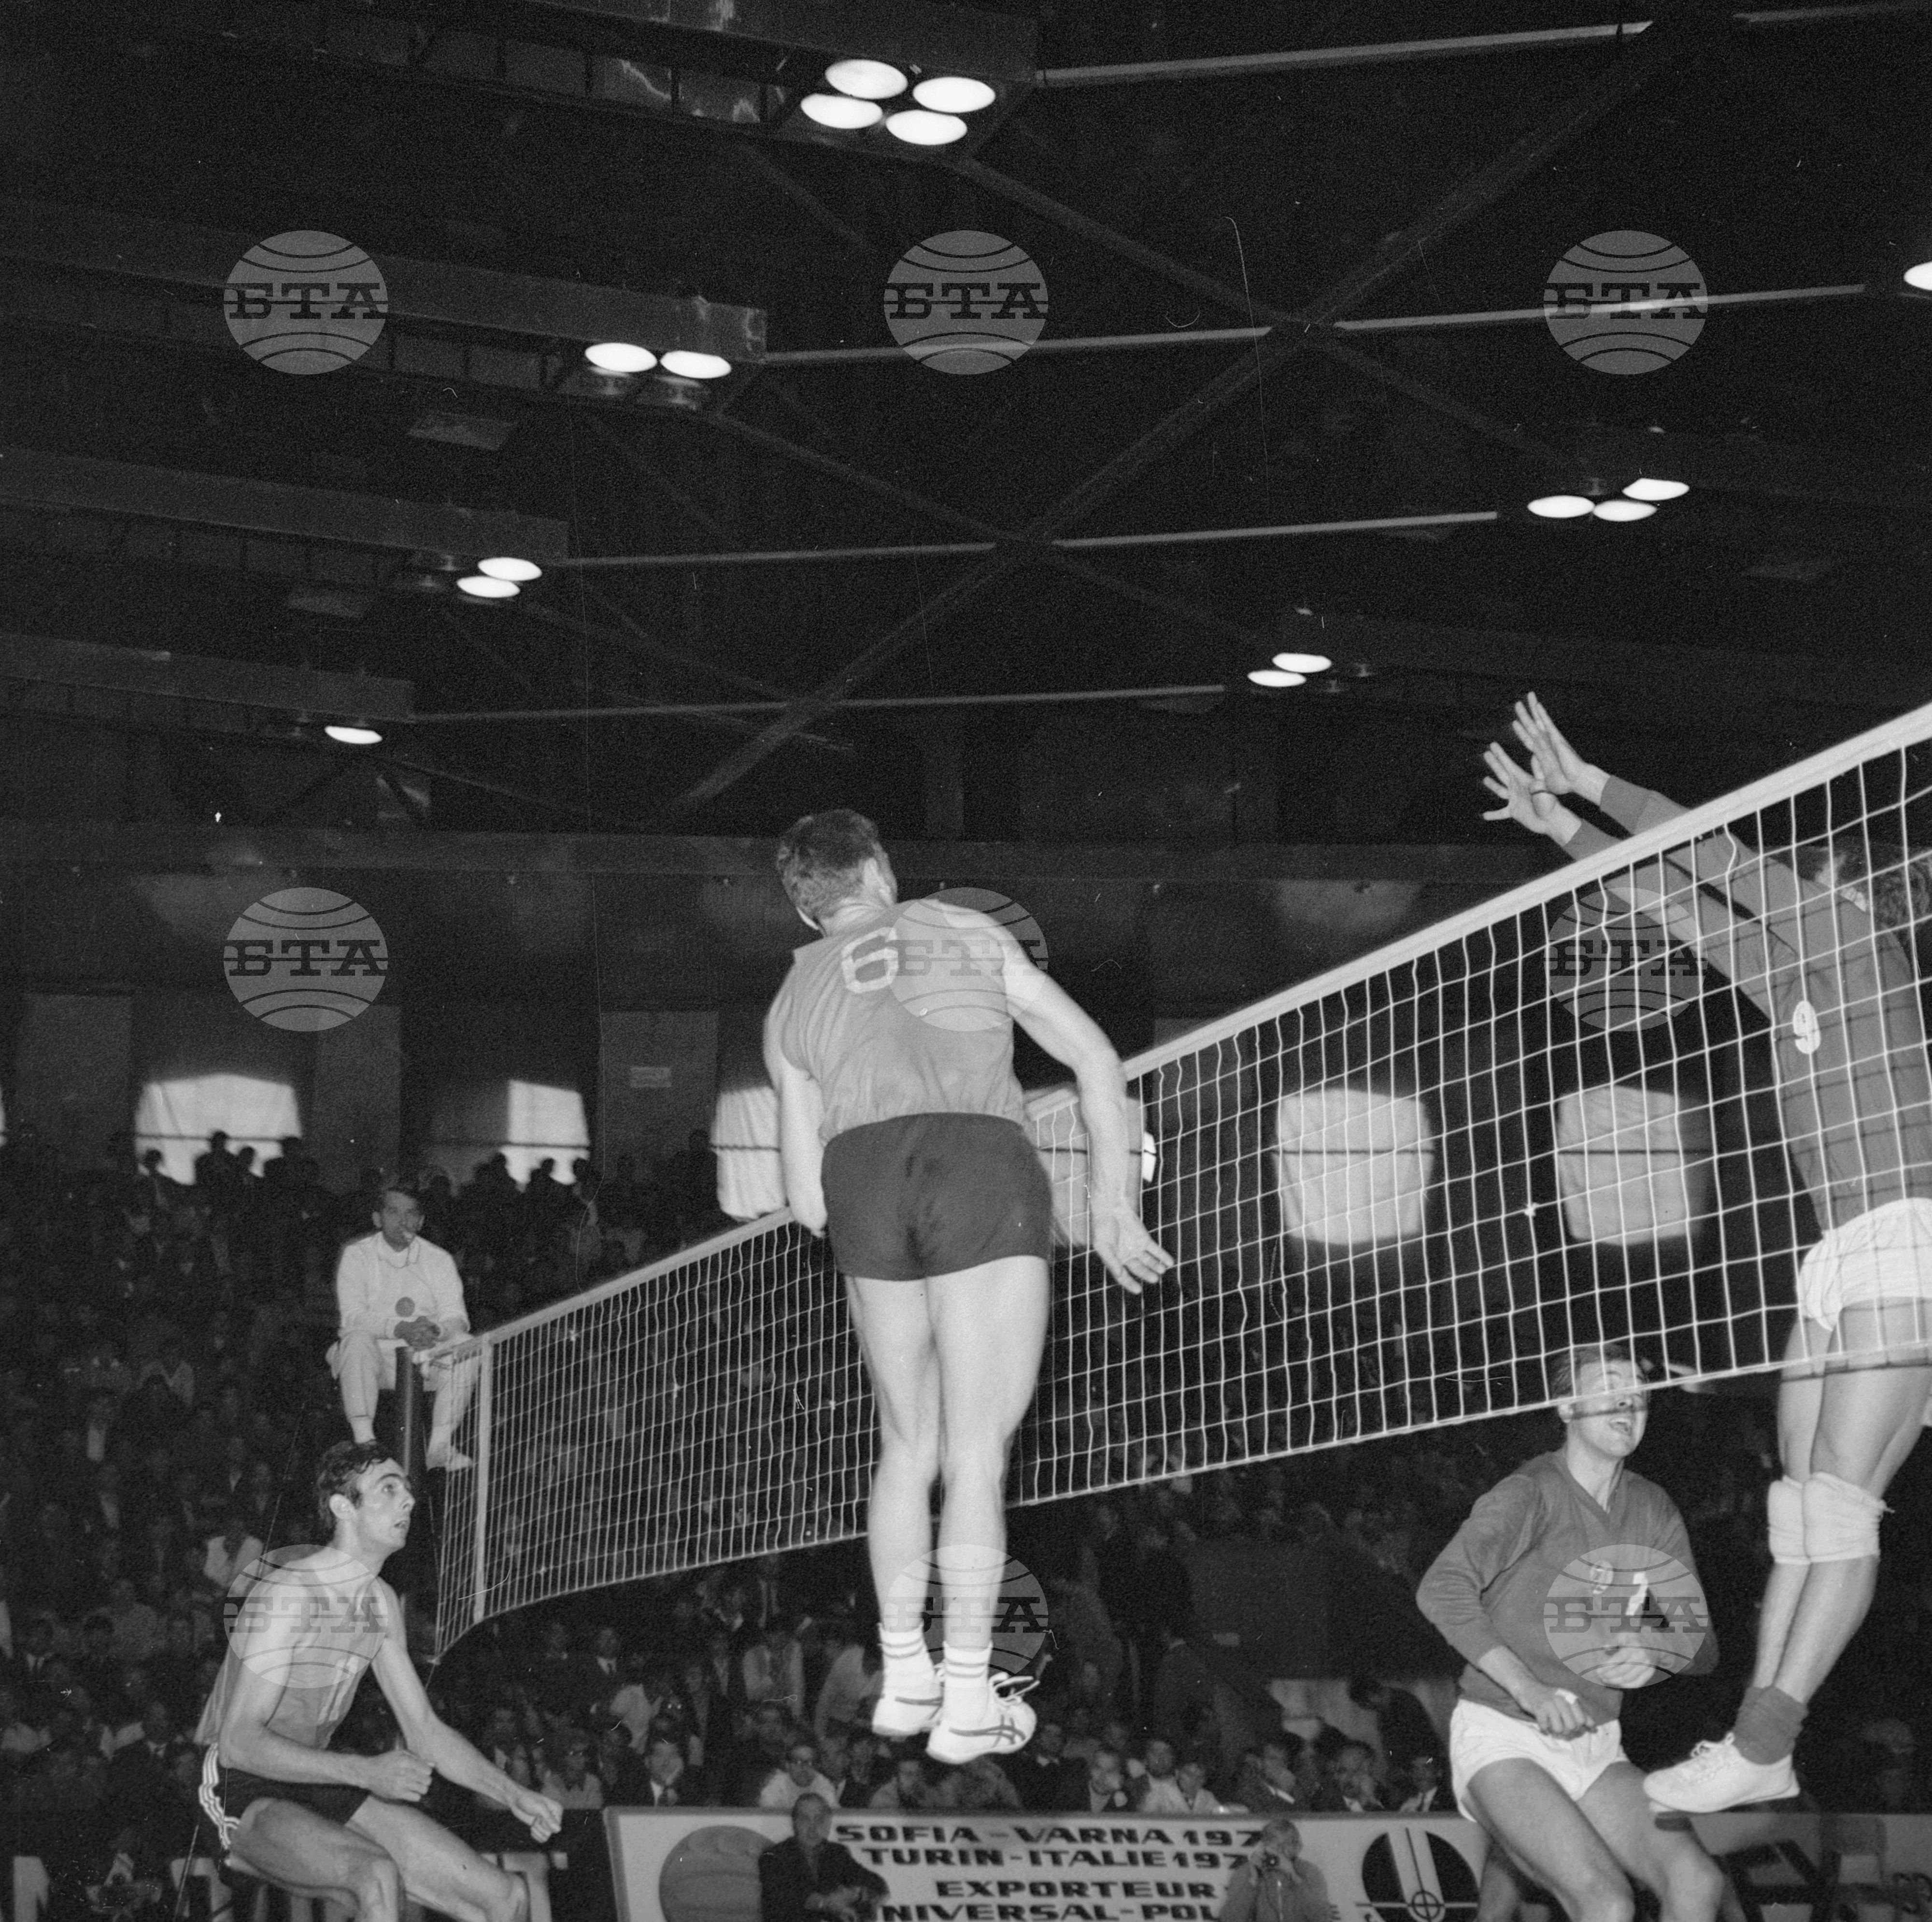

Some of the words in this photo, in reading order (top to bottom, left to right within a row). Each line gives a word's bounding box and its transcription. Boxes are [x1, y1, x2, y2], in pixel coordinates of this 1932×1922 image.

[841, 926, 898, 994] 6
[1182, 1830, 1264, 1846] 197
[1172, 1851, 1249, 1869] 197
[936, 1881, 1217, 1898] EXPORTEUR
